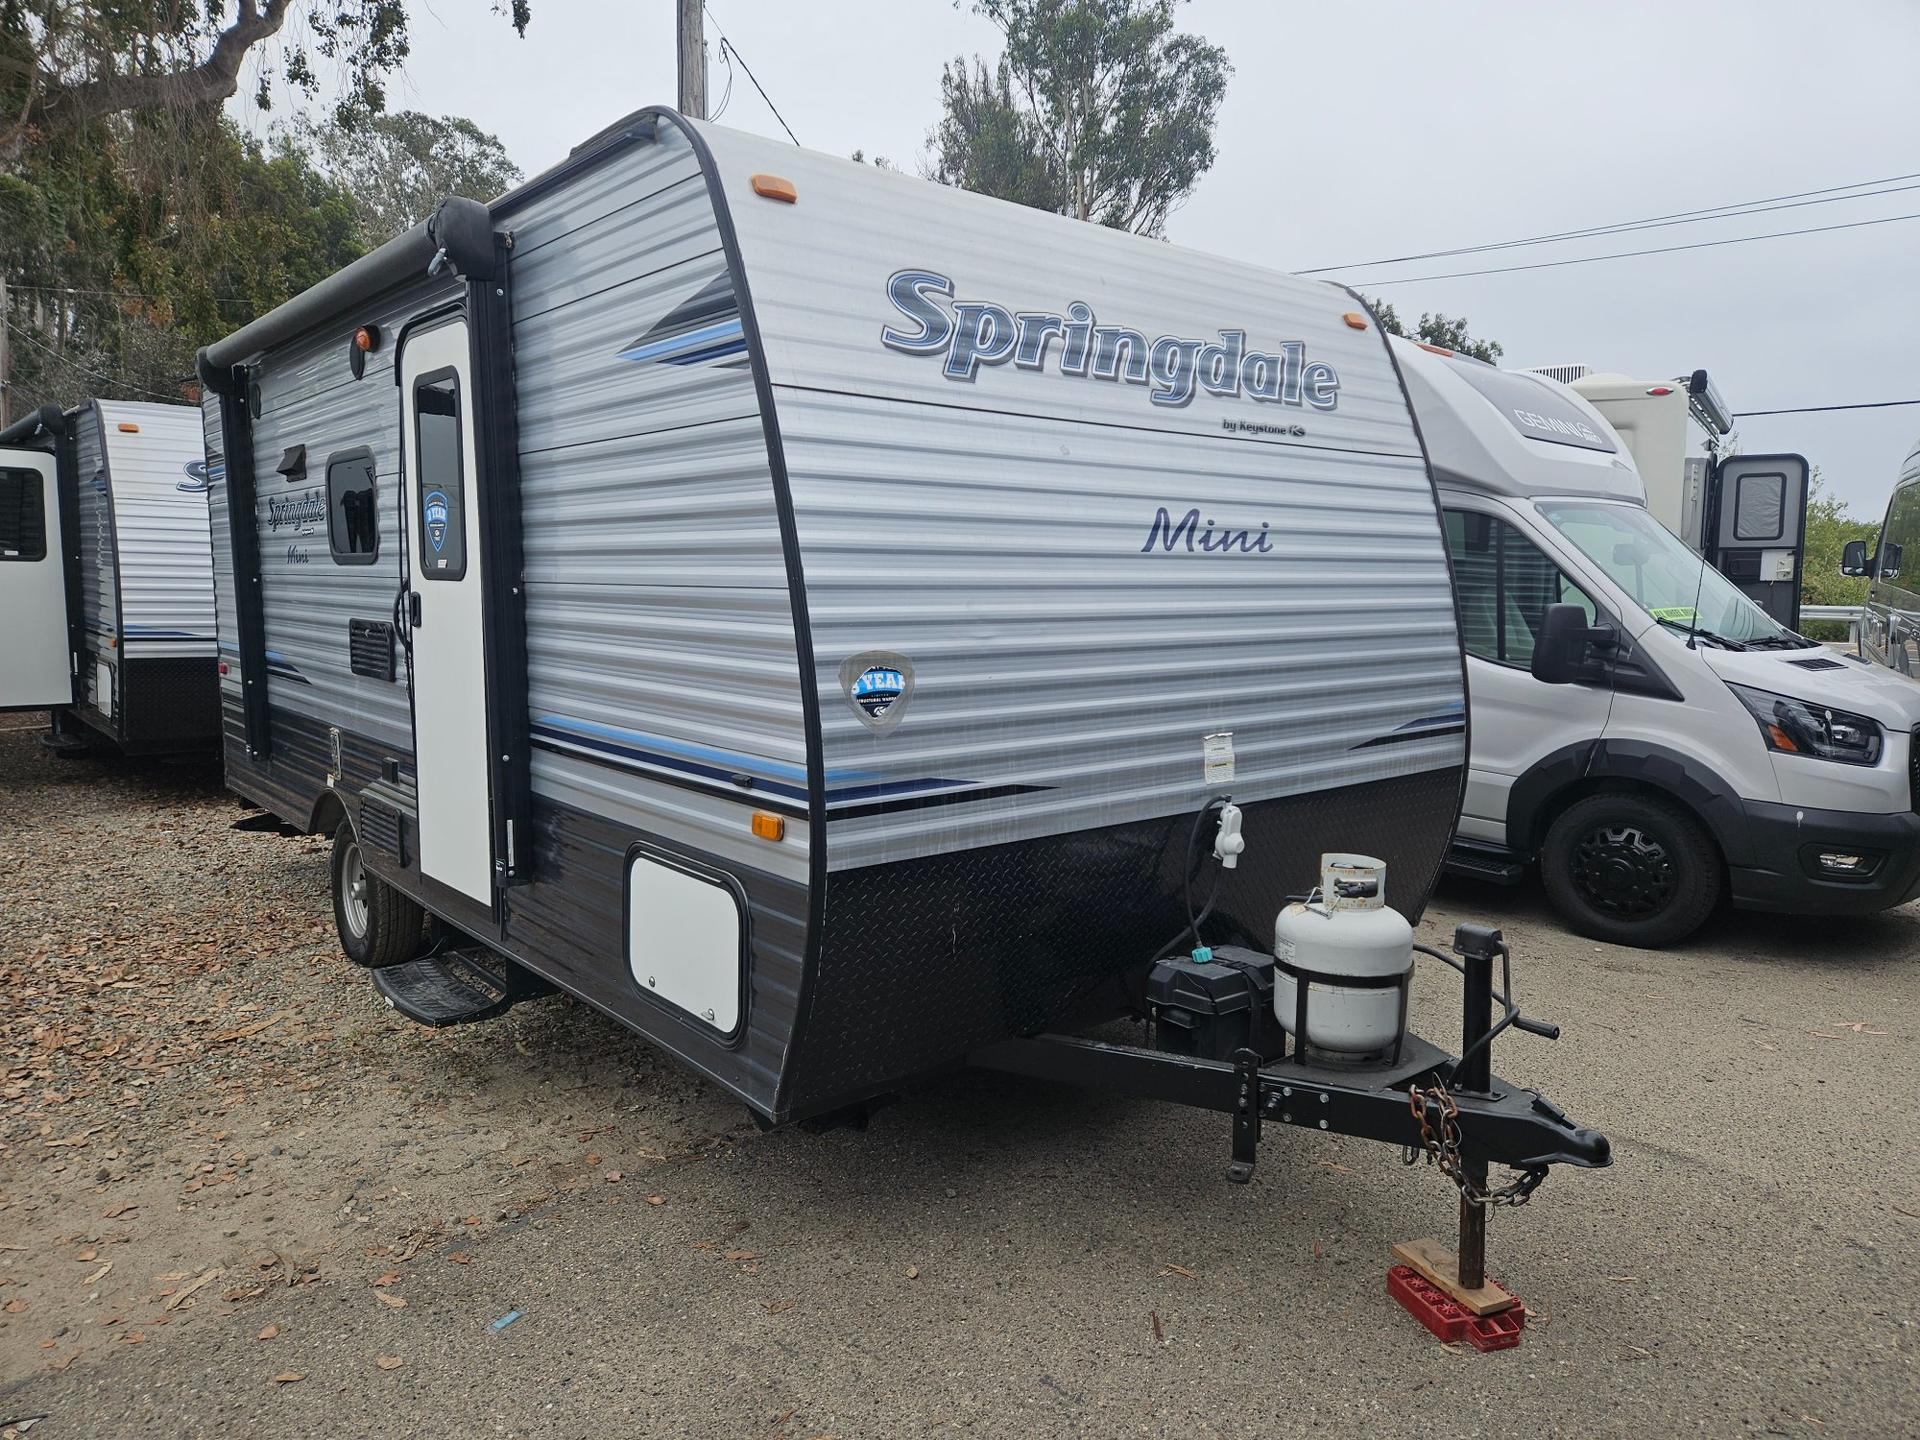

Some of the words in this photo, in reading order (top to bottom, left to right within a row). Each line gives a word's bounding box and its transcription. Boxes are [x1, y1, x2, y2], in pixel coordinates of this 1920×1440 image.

[880, 268, 1341, 410] Springdale
[1223, 419, 1236, 432] by
[1239, 421, 1287, 435] Keystone
[1513, 408, 1583, 438] GEMINI
[267, 489, 327, 533] Springdale
[1140, 506, 1274, 554] Mini
[287, 544, 310, 564] Mini
